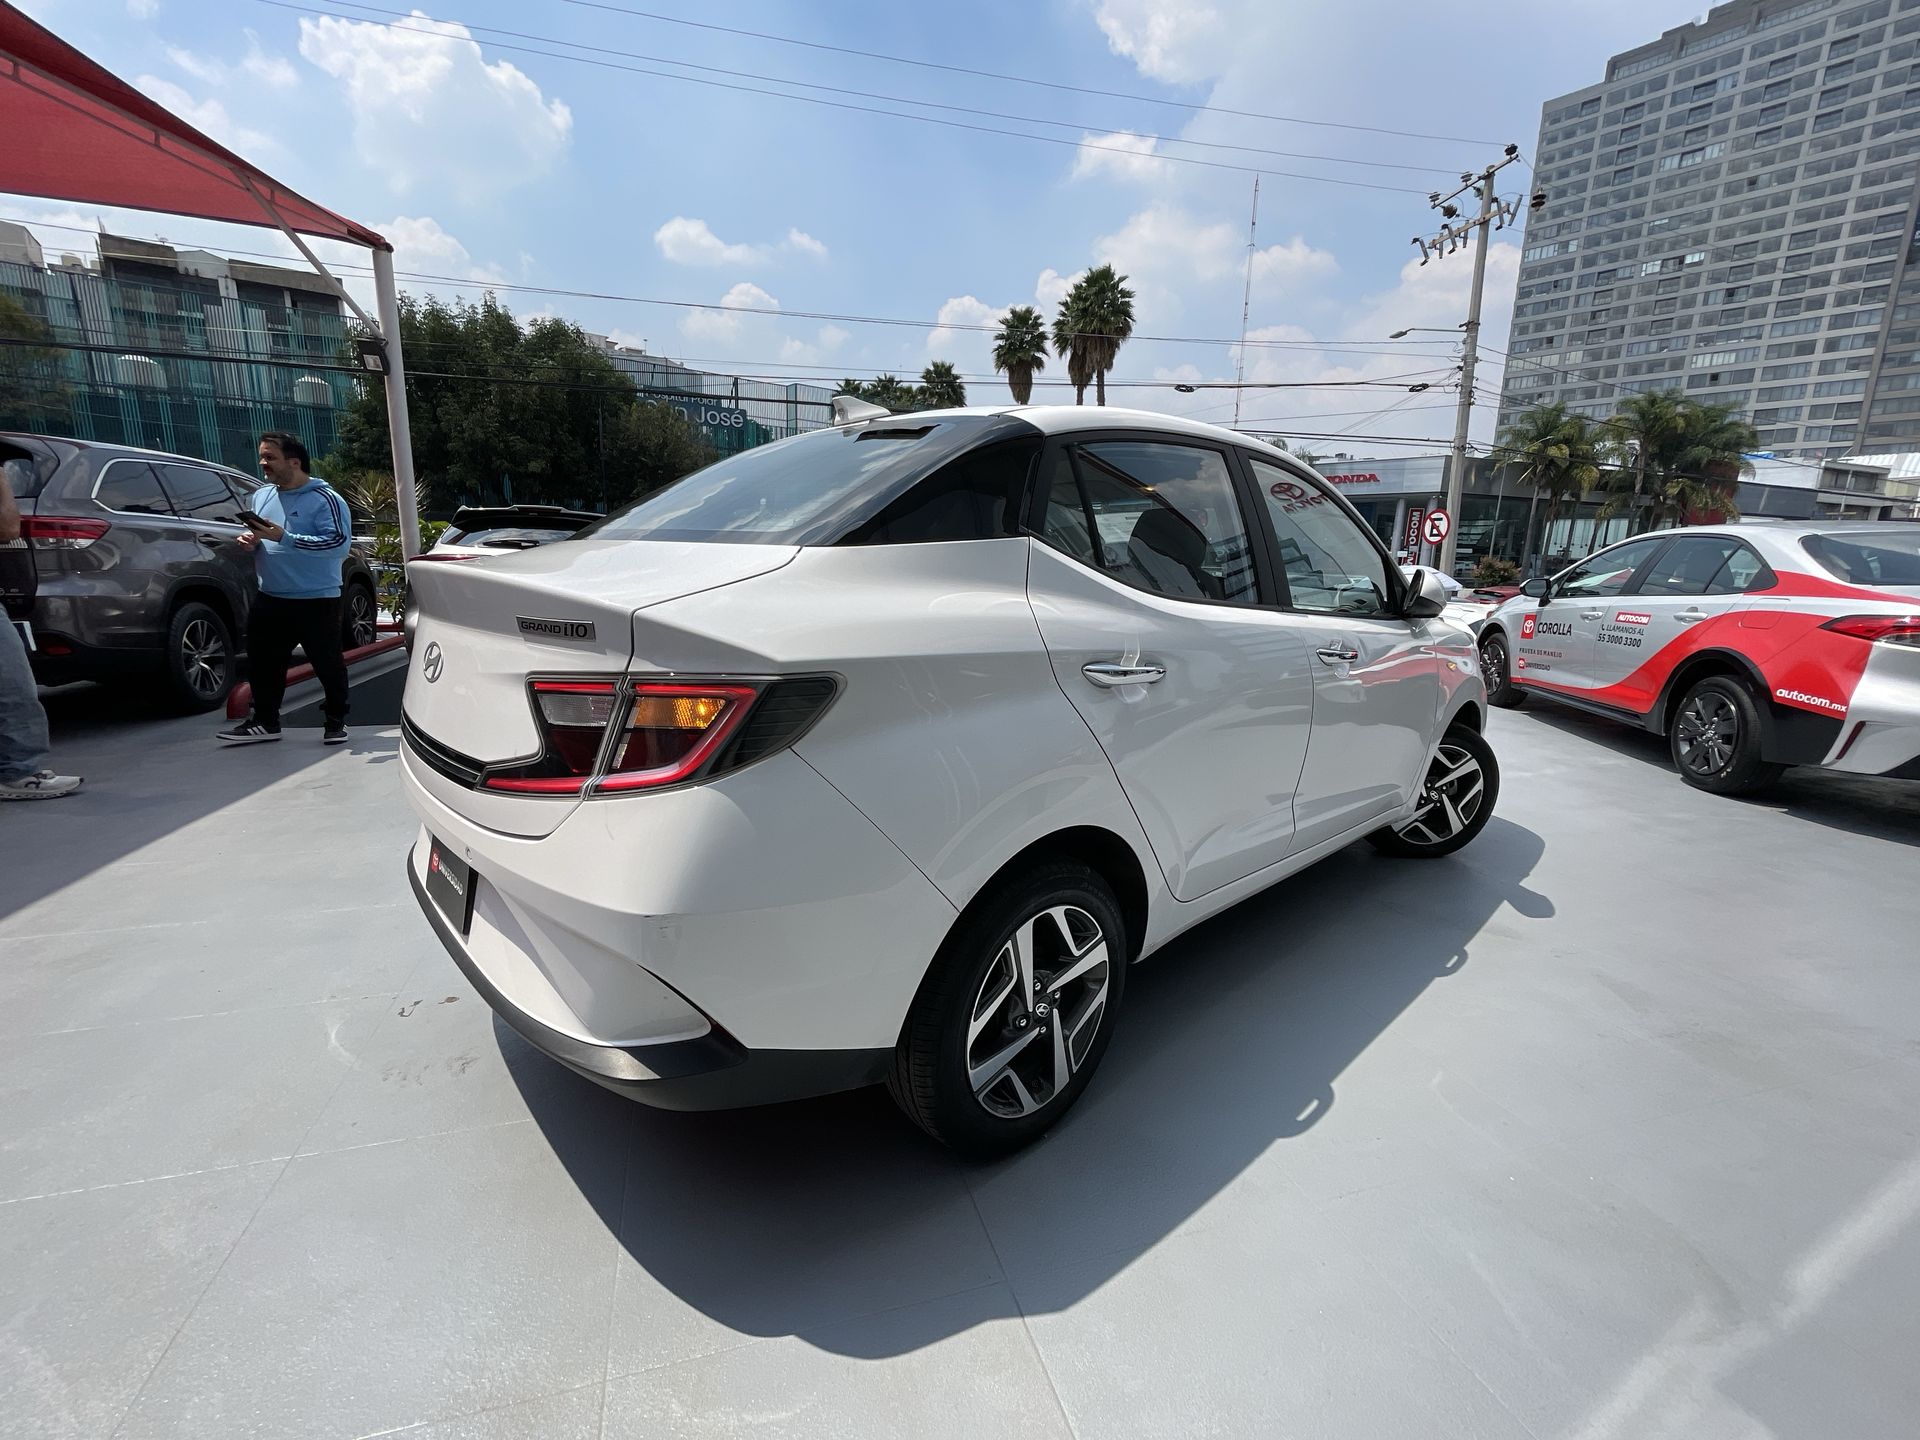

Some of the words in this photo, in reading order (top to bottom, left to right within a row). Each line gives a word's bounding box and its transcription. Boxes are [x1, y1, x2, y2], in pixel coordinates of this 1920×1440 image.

[695, 407, 744, 428] José
[1616, 614, 1650, 624] AUTOCOM
[520, 621, 561, 634] GRAND
[563, 623, 588, 638] i10
[1537, 622, 1572, 636] COROLLA
[1637, 628, 1645, 636] AL
[1597, 633, 1606, 642] 55
[1606, 634, 1623, 645] 3000
[1623, 636, 1642, 648] 3300
[1776, 688, 1848, 712] autocom.mx
